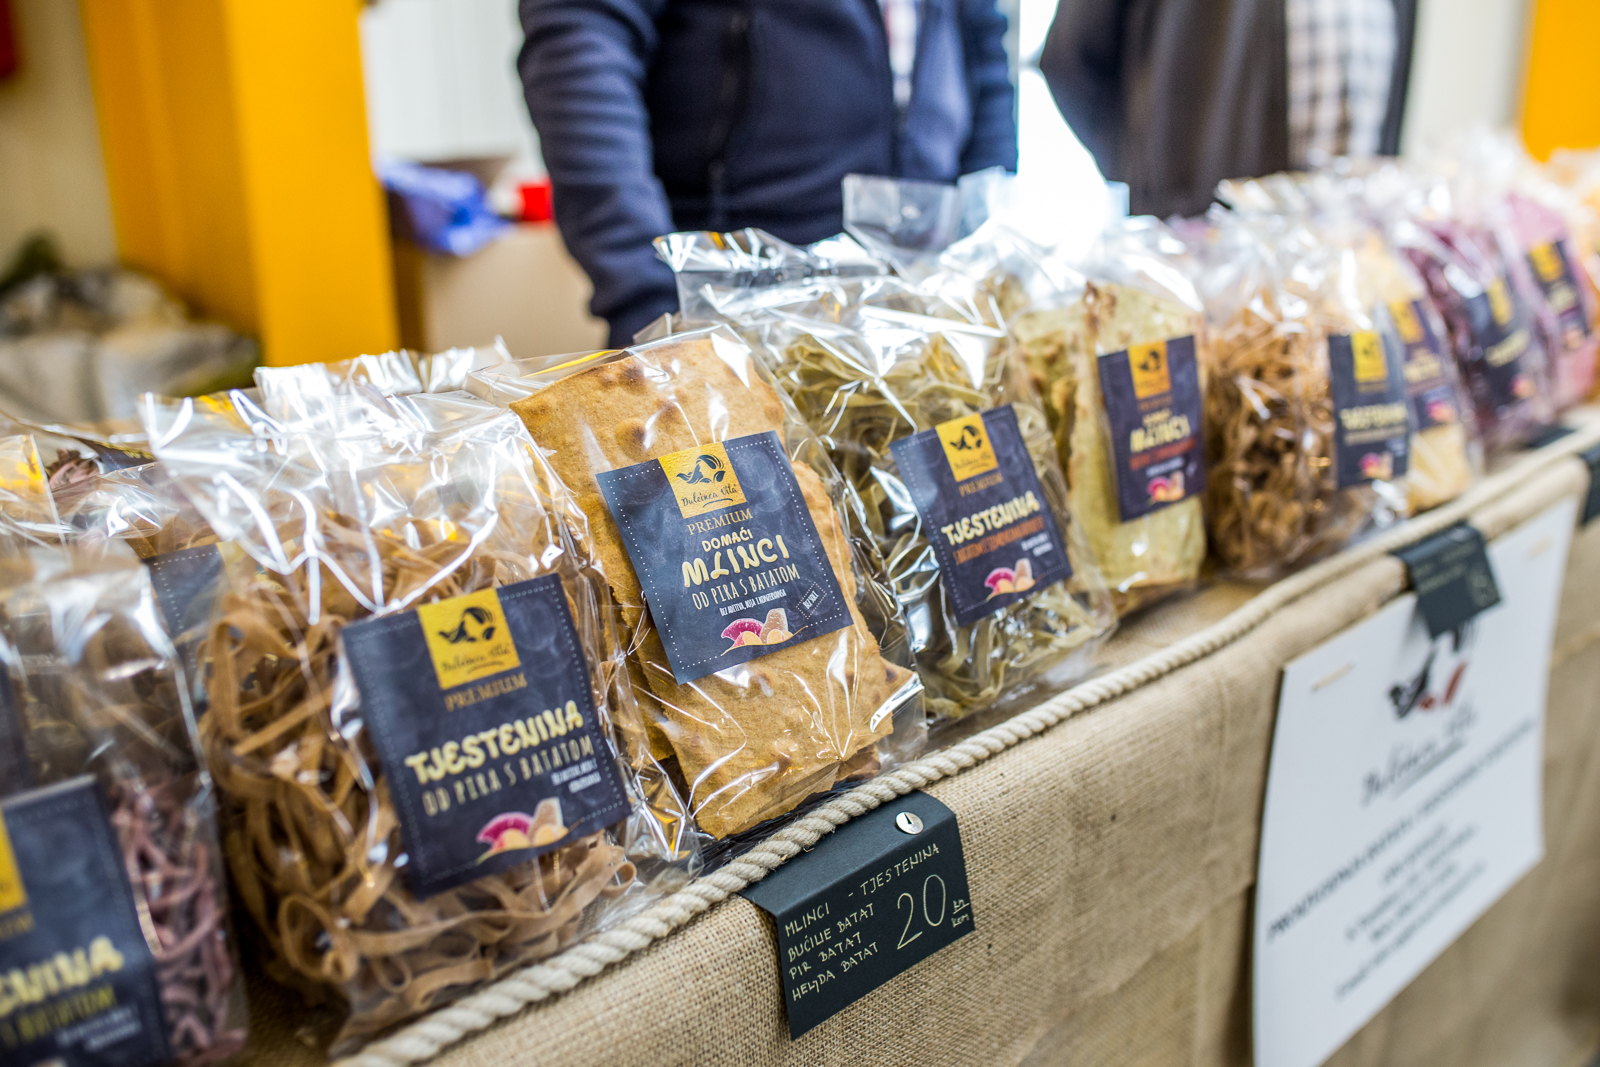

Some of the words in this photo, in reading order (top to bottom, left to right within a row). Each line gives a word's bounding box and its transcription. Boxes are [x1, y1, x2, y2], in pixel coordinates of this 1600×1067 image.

[687, 508, 753, 535] PREMIUM
[941, 490, 1040, 546] TJESTENINA
[682, 534, 789, 588] MLINCI
[692, 592, 710, 610] OD
[711, 582, 740, 604] PIRA
[740, 578, 748, 595] S
[748, 563, 800, 592] BATATOM
[444, 672, 528, 712] PREMIUM
[404, 700, 584, 785] TJESTENINA
[422, 786, 451, 817] OD
[453, 768, 502, 805] PIRA
[503, 762, 516, 787] S
[520, 734, 594, 780] BATATOM
[785, 902, 829, 937] MLINCI
[860, 843, 940, 895] TJESTENINA
[897, 873, 946, 950] 20
[837, 903, 874, 933] BATAT
[789, 961, 812, 980] PIR
[818, 931, 861, 962] BATAT
[840, 941, 878, 973] BATAT
